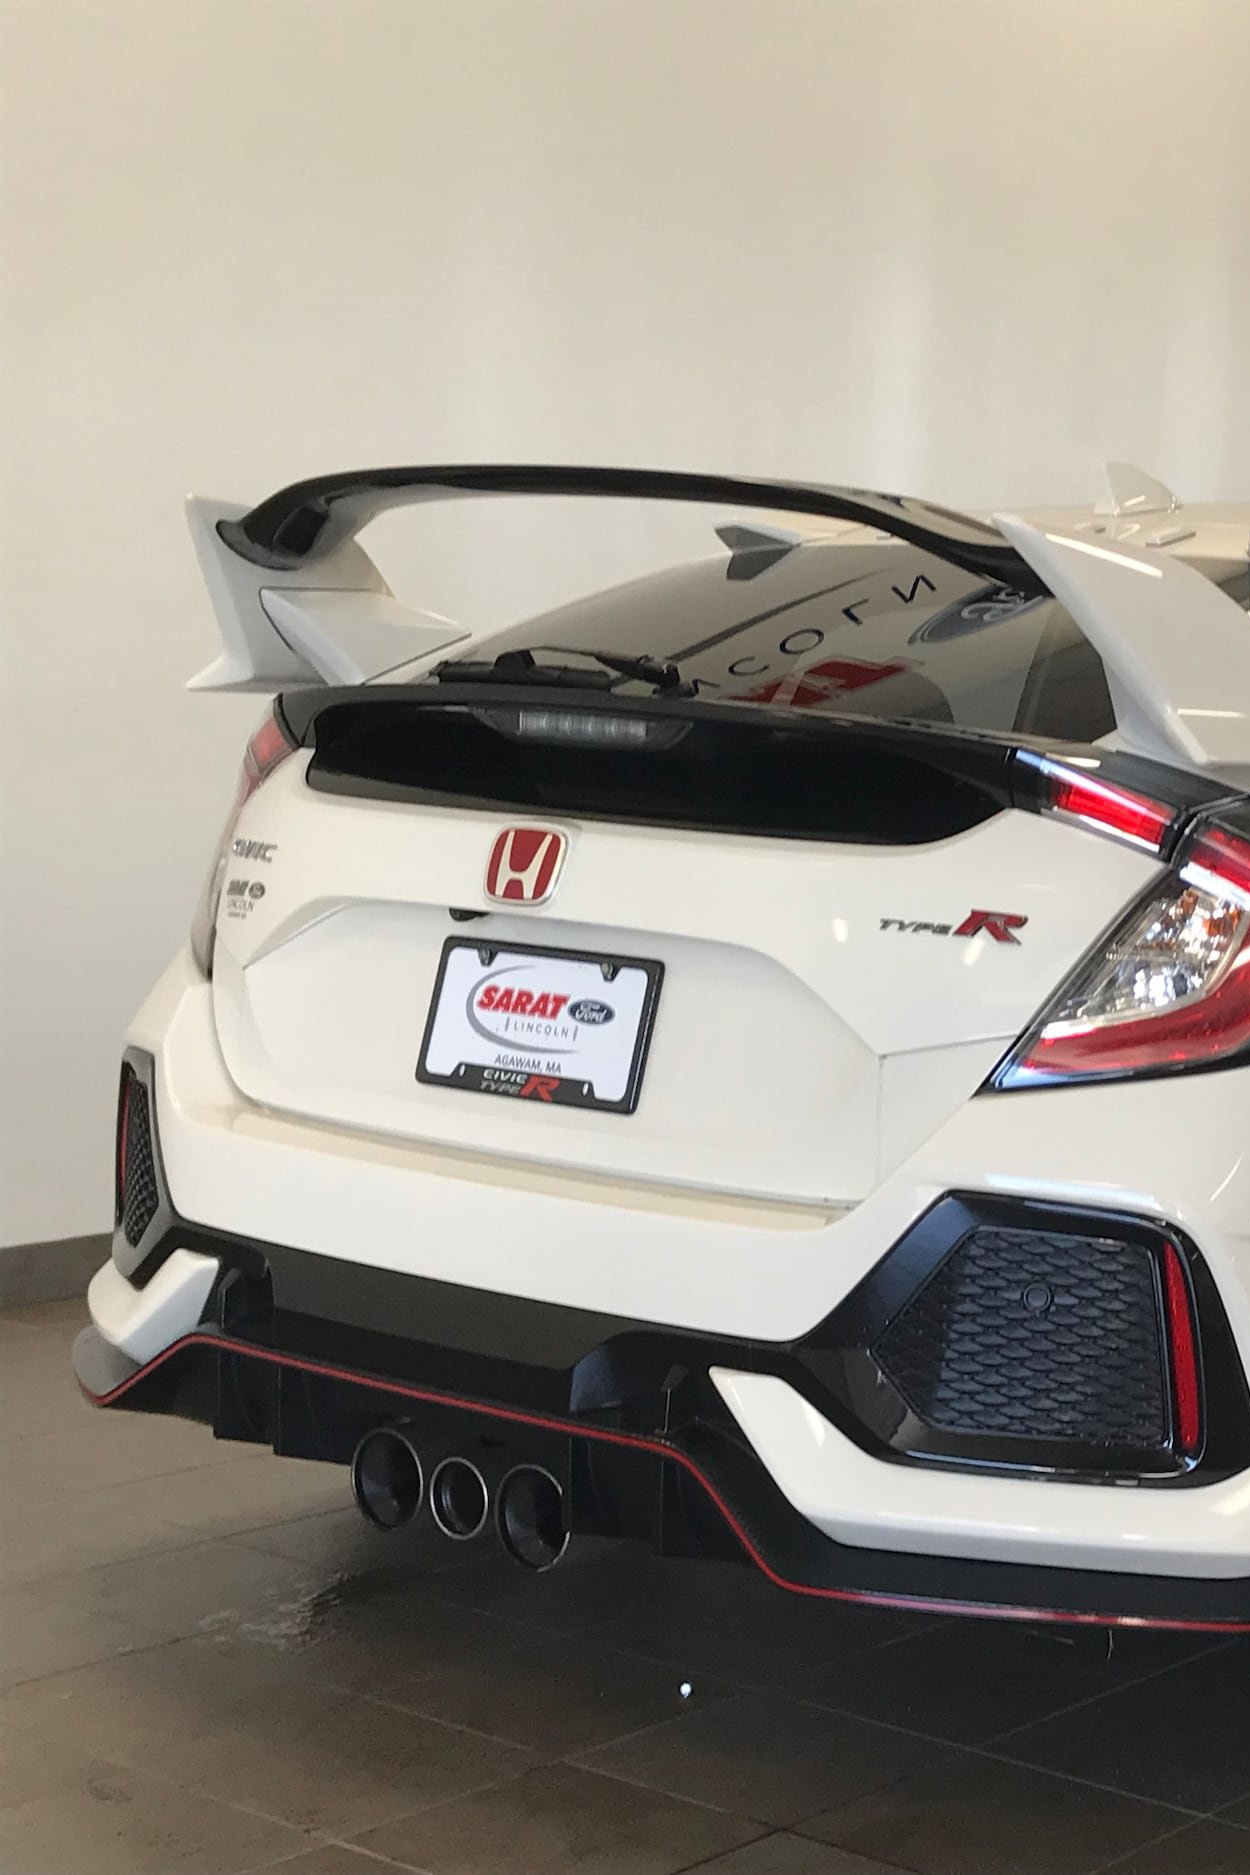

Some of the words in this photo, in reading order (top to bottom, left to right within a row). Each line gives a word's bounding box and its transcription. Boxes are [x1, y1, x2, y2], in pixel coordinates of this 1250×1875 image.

[879, 918, 953, 936] TYPE
[952, 908, 1028, 946] R
[477, 984, 570, 1020] SARAT
[575, 1003, 608, 1023] Ford
[513, 1021, 569, 1039] LINCOLN
[494, 1053, 543, 1073] AGAWAM,
[545, 1060, 562, 1073] MA
[481, 1080, 520, 1096] TYPE
[520, 1073, 560, 1104] R
[483, 1068, 528, 1084] CIVIC
